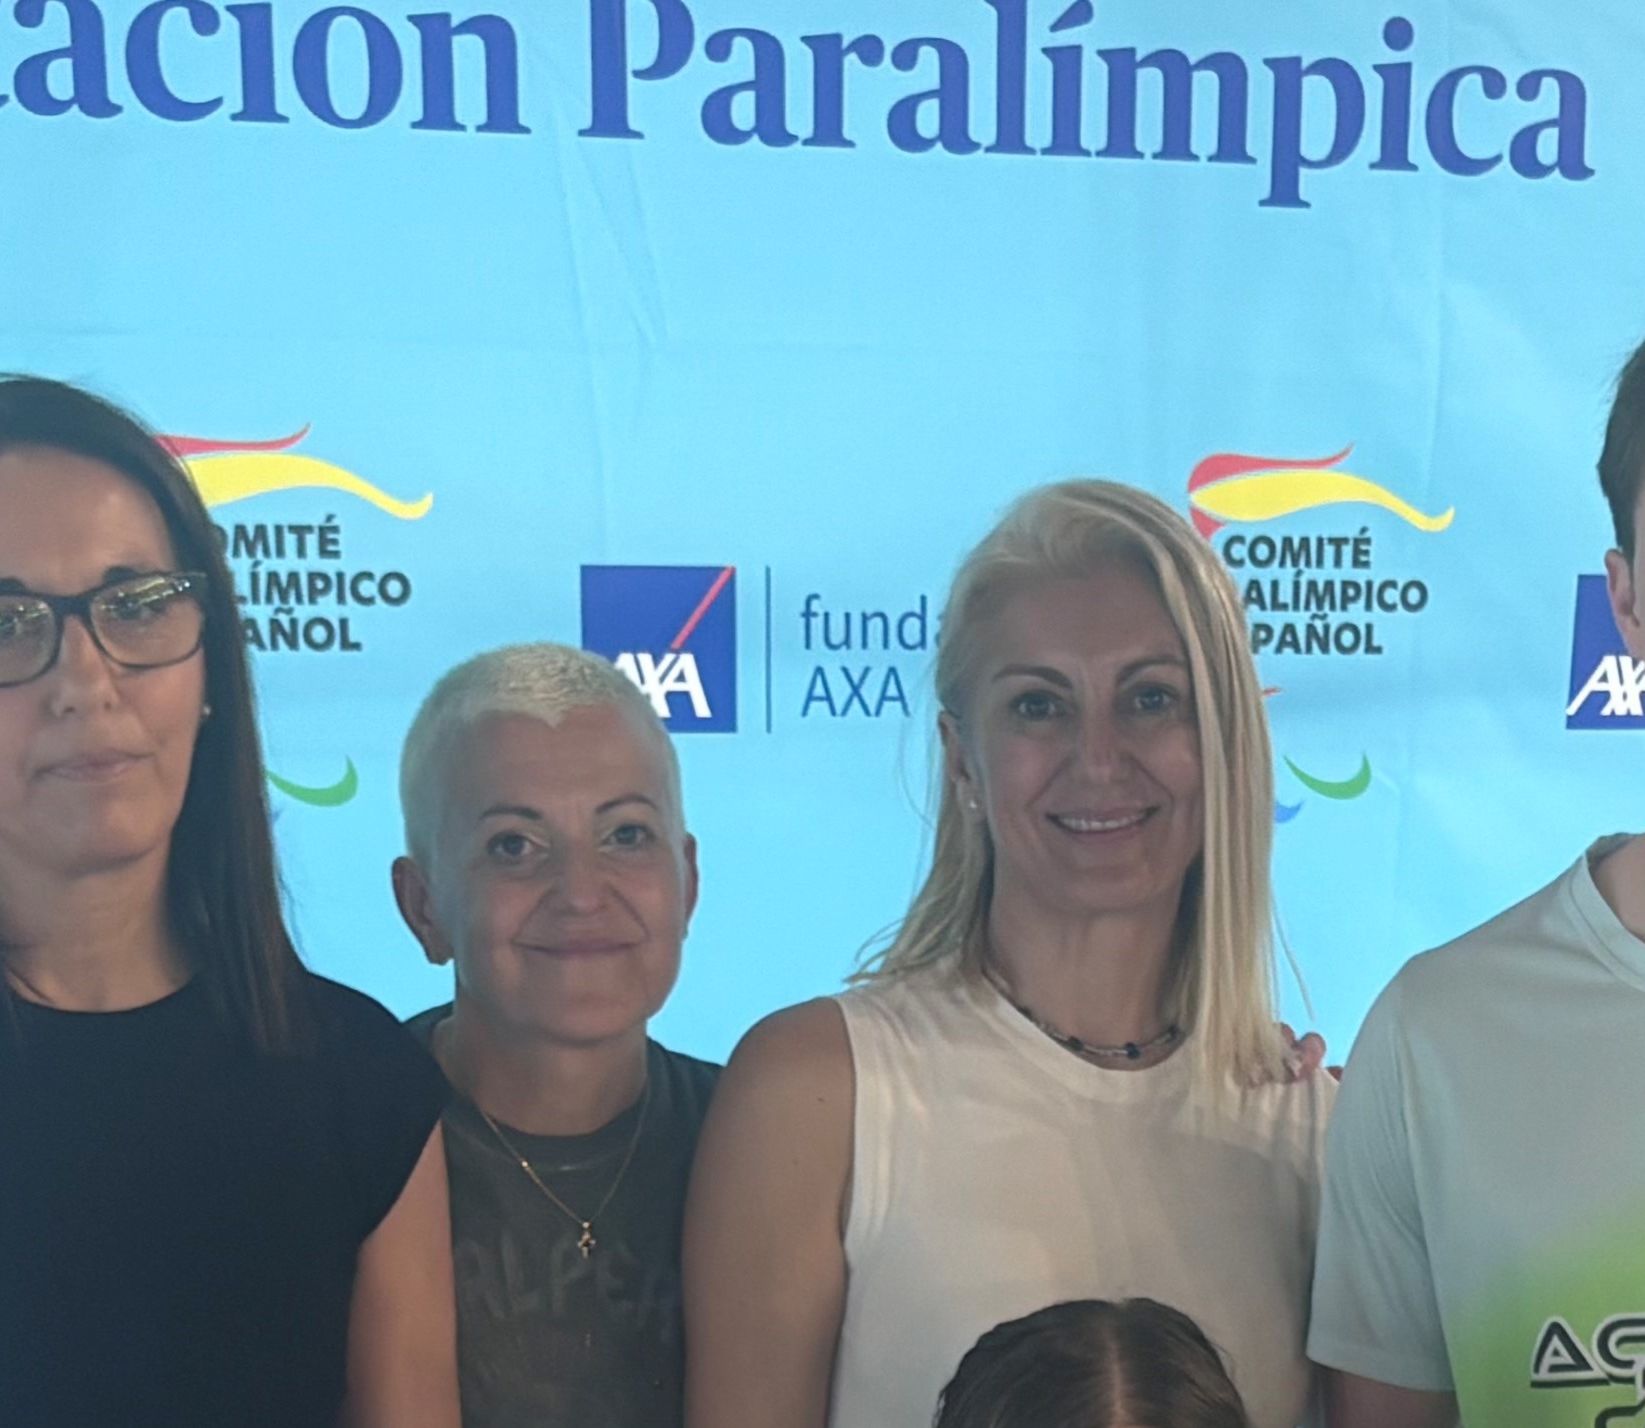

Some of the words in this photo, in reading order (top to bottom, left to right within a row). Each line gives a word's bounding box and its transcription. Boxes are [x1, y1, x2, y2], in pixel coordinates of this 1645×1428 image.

[578, 0, 1596, 209] Paralímpica
[1222, 525, 1373, 569] COMITÉ
[800, 665, 911, 718] AXA
